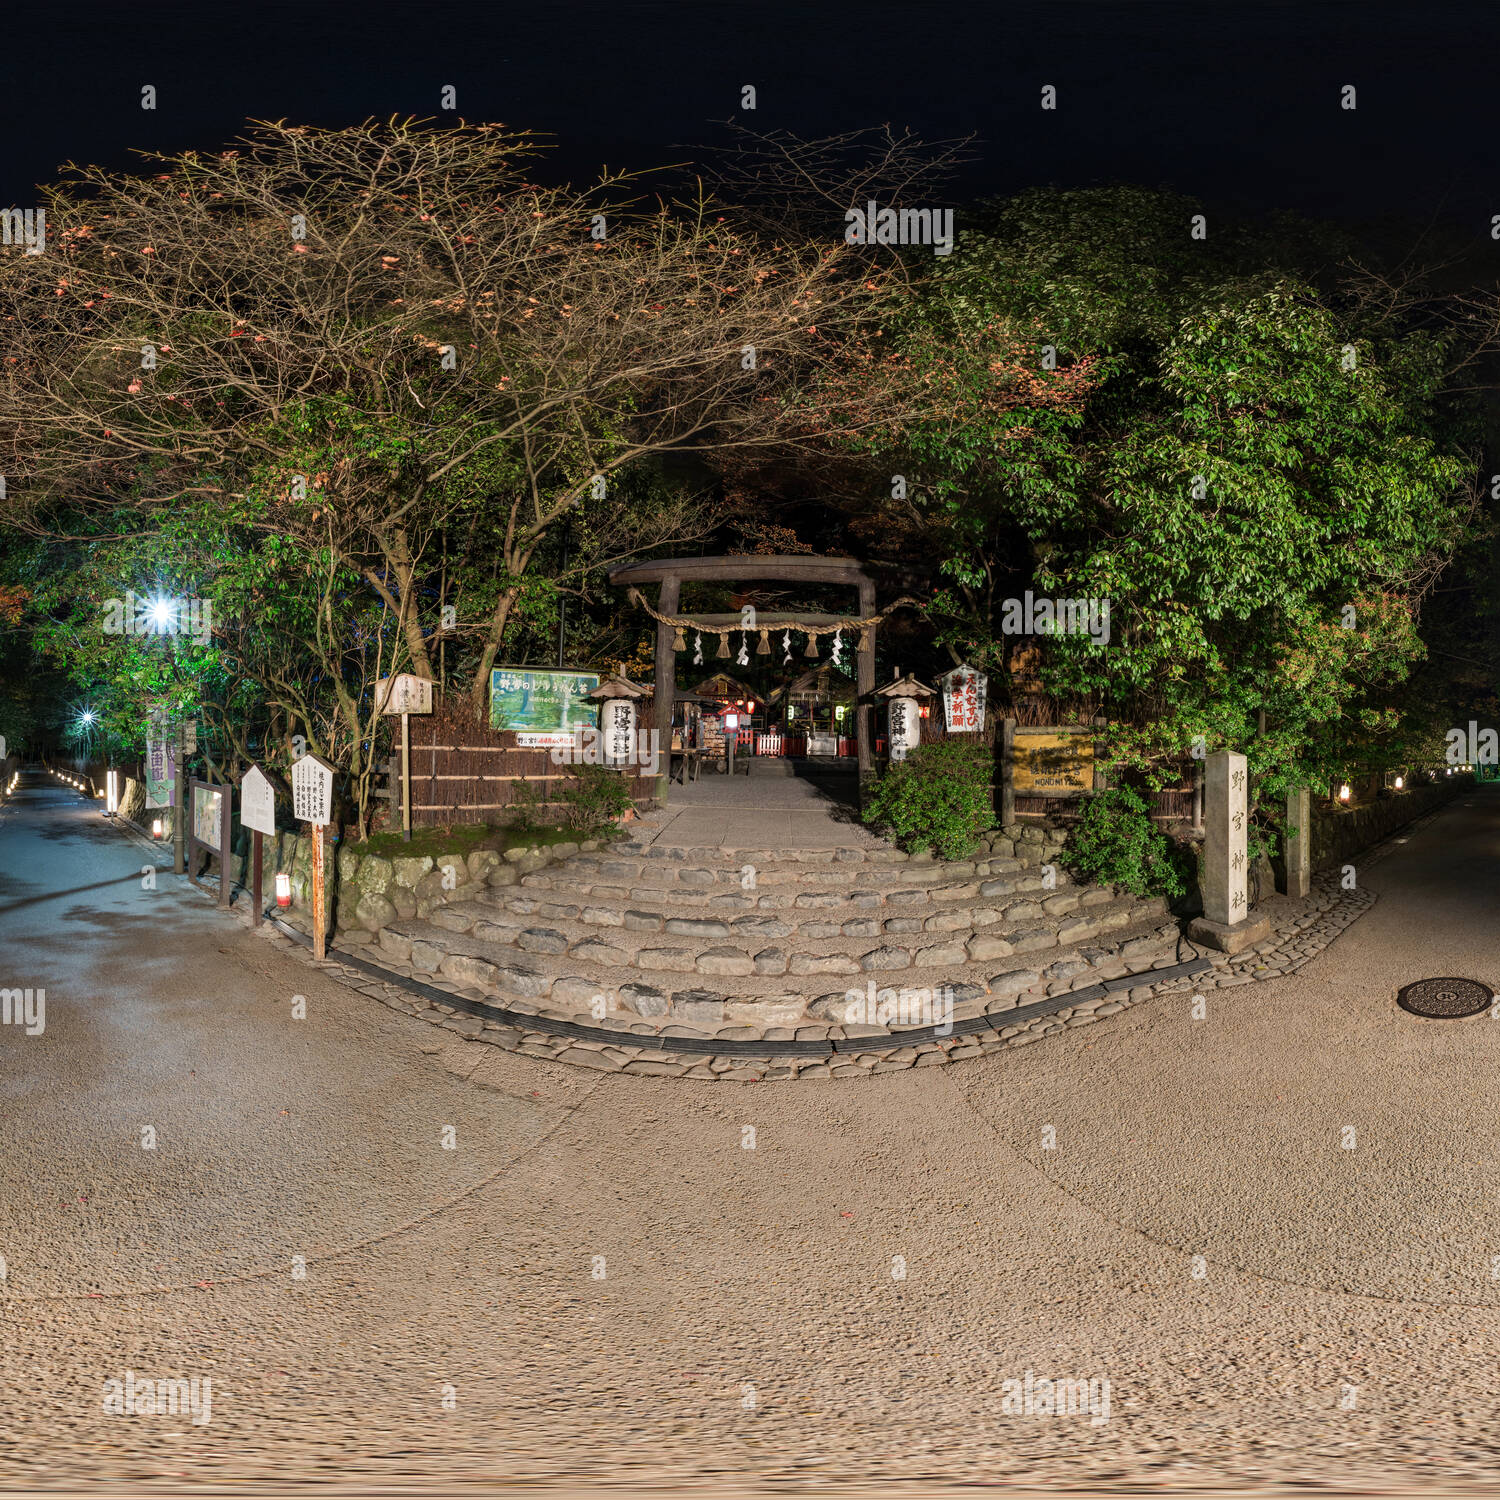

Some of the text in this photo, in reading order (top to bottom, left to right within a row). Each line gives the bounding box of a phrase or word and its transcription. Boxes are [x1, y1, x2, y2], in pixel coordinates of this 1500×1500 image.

[951, 674, 964, 727] 進学祈願
[965, 673, 979, 727] えんむすび
[613, 705, 631, 754] 野宮神社
[1231, 770, 1246, 909] 野宮神社
